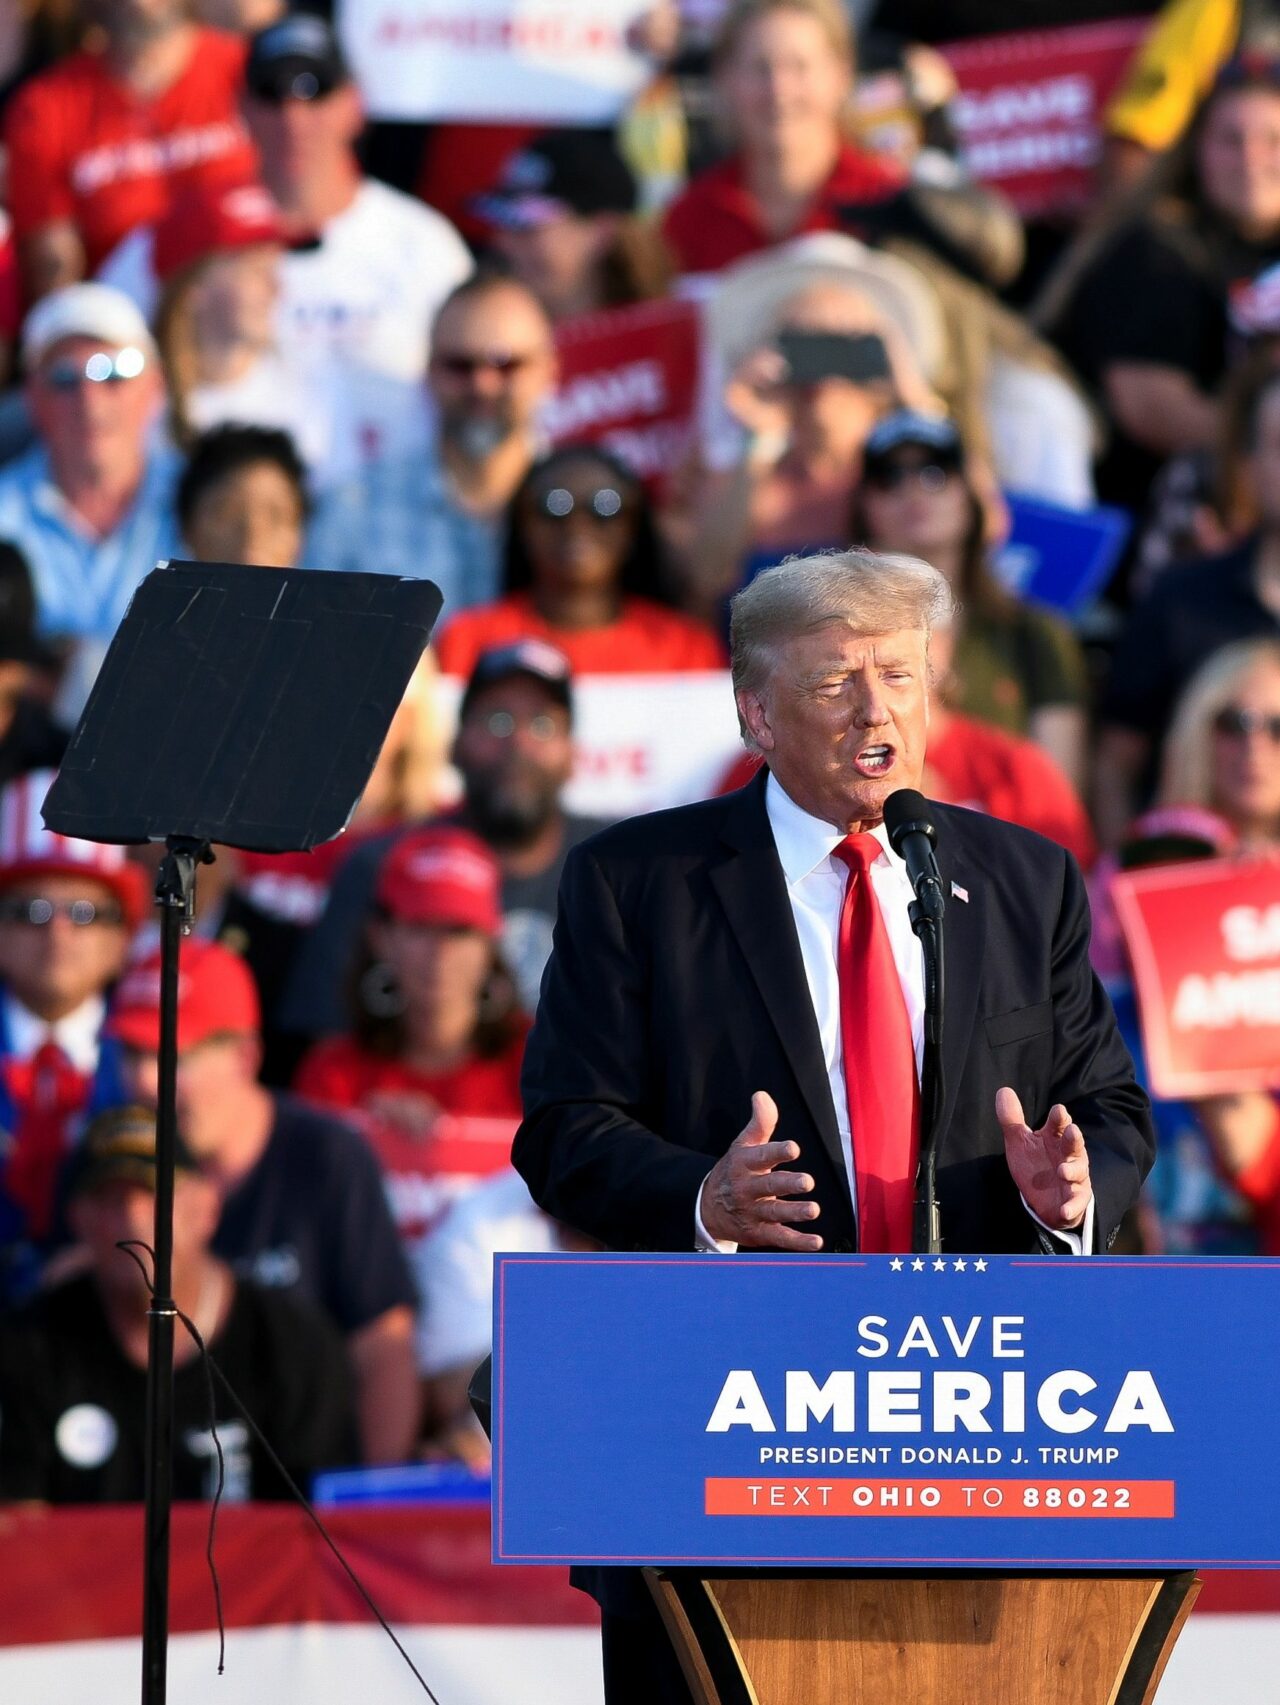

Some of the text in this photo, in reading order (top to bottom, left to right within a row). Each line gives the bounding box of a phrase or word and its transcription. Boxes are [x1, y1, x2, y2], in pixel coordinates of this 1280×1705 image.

[857, 1315, 1025, 1358] SAVE
[705, 1369, 1175, 1434] AMERICA
[760, 1447, 1119, 1464] PRESIDENT DONALD J. TRUMP
[747, 1485, 1131, 1508] TEXT OHIO TO 88022
